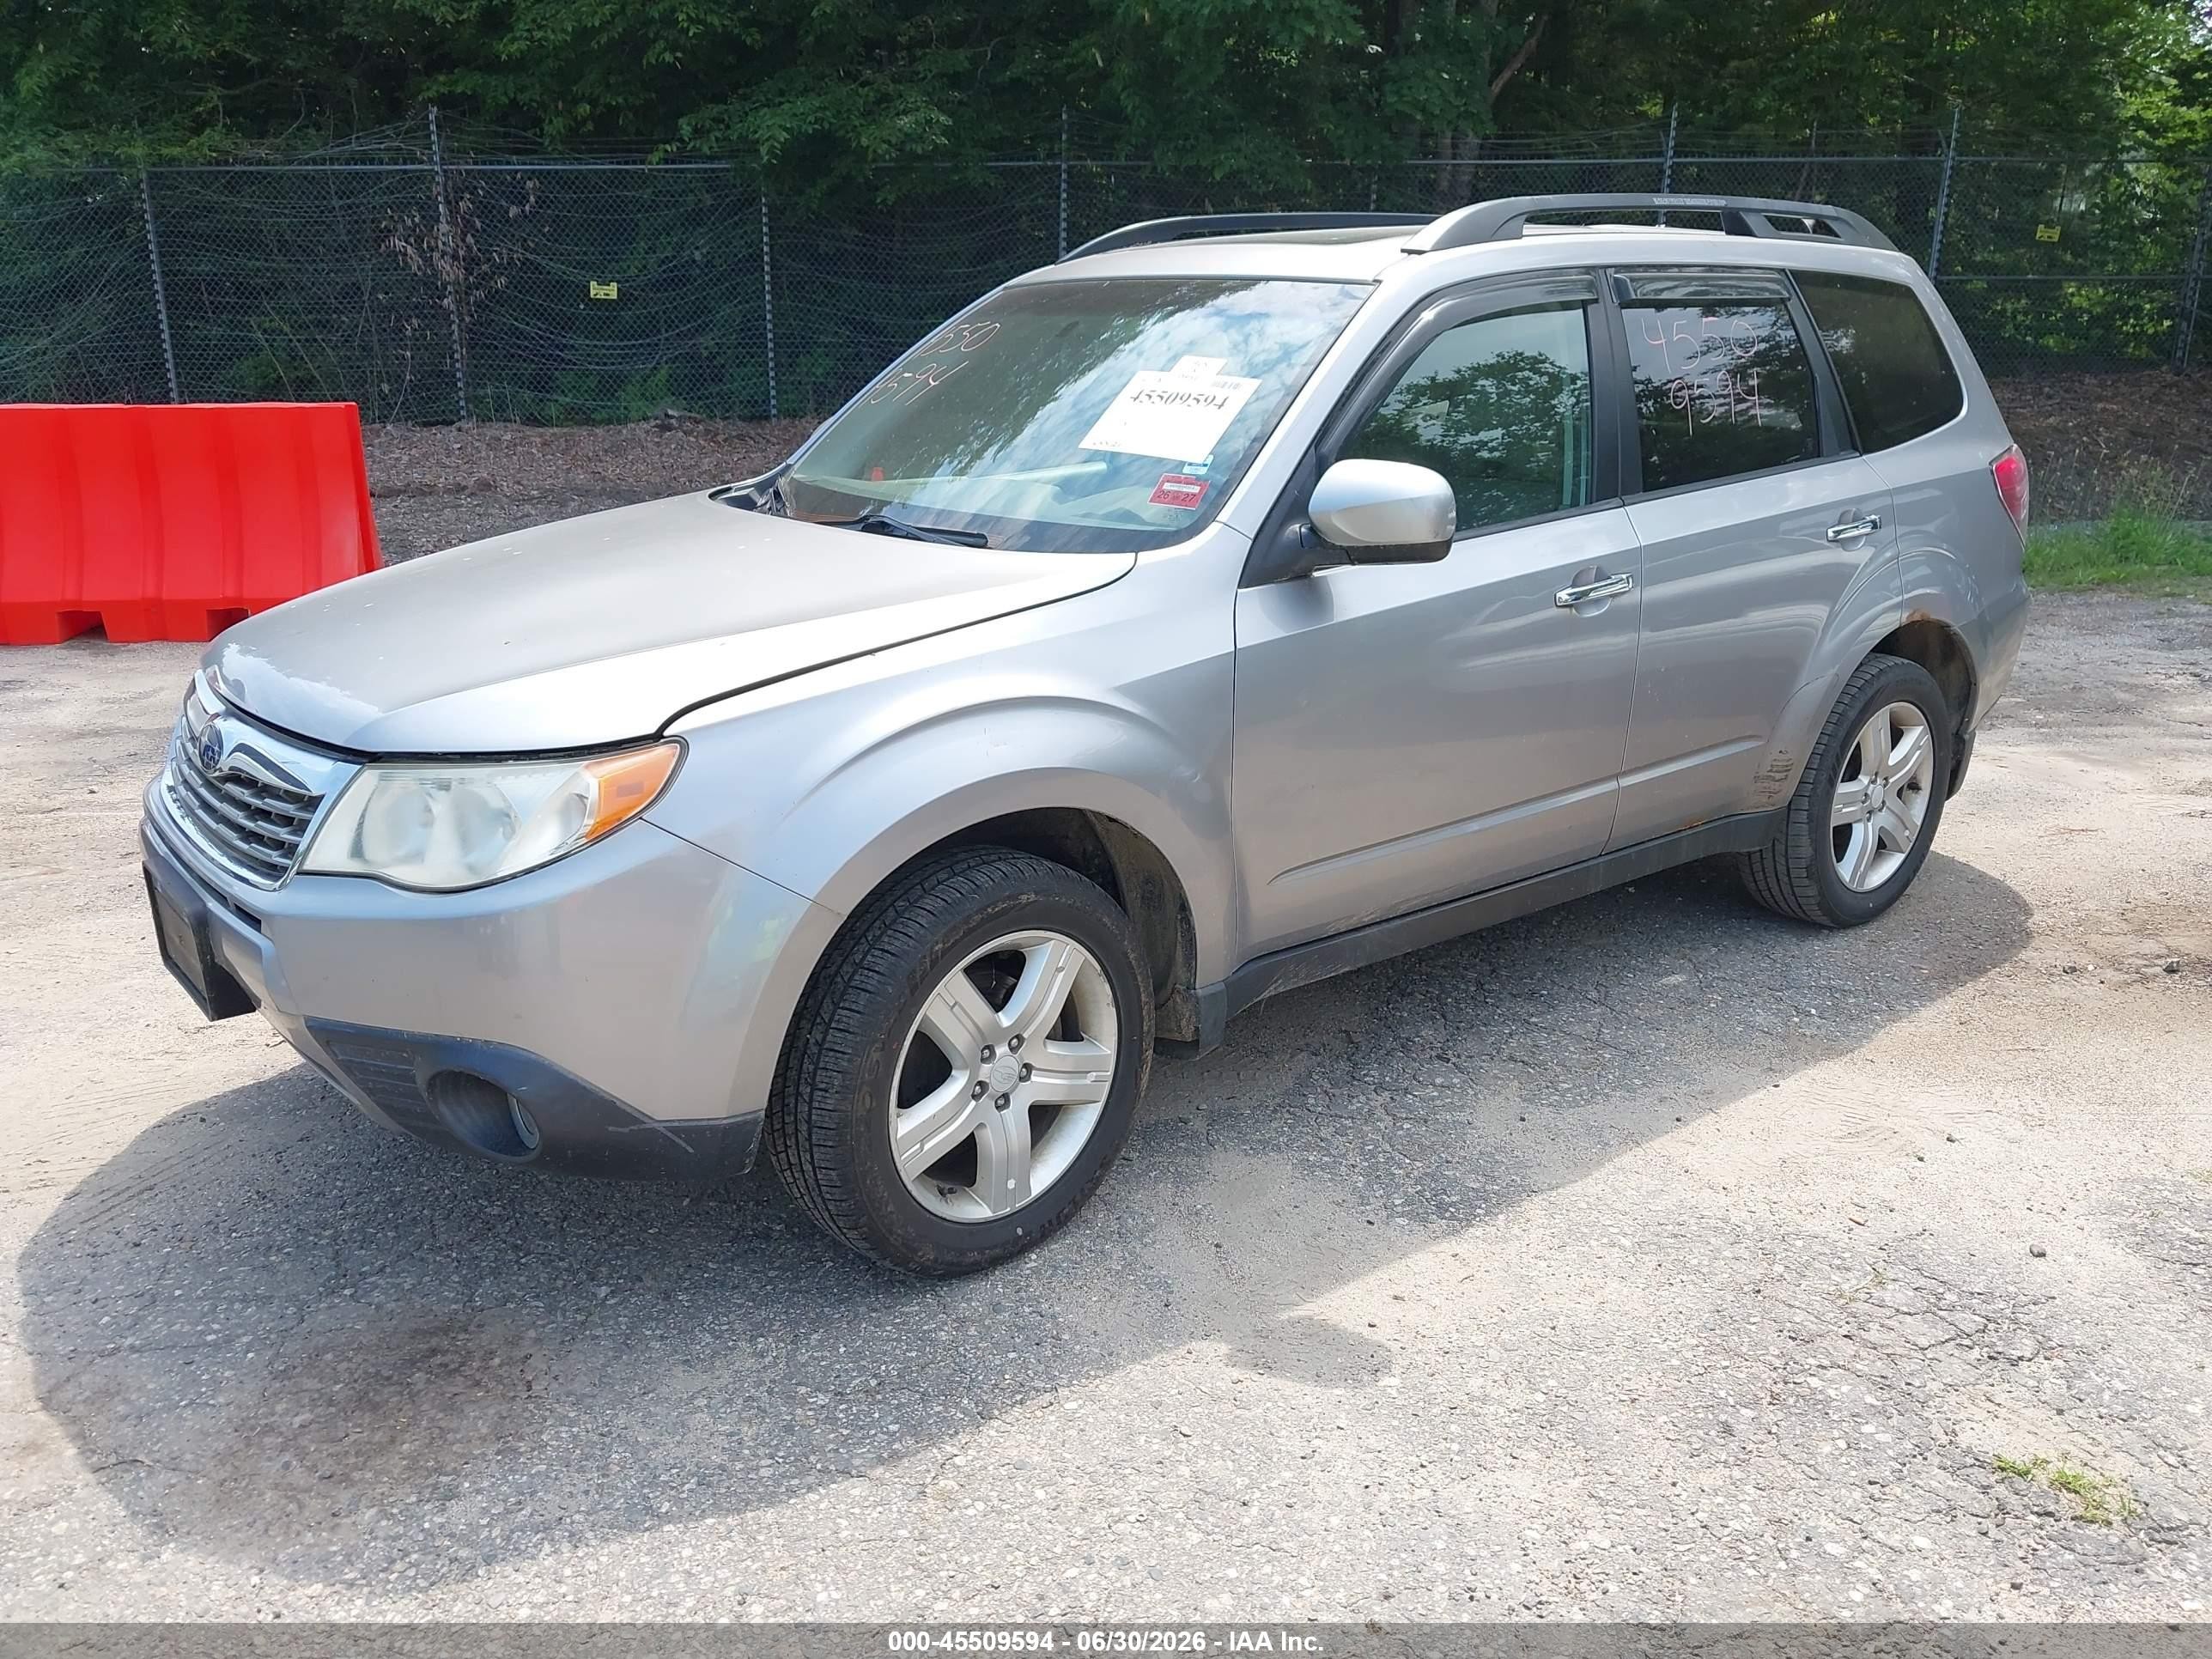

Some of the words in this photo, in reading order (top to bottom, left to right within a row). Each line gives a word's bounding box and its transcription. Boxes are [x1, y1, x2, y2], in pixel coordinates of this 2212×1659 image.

[912, 321, 1000, 358] 550
[1641, 316, 1758, 374] 4550
[1129, 389, 1230, 410] 45509594
[1670, 370, 1762, 436] 9594
[1157, 489, 1170, 500] 26
[1181, 493, 1196, 502] 27
